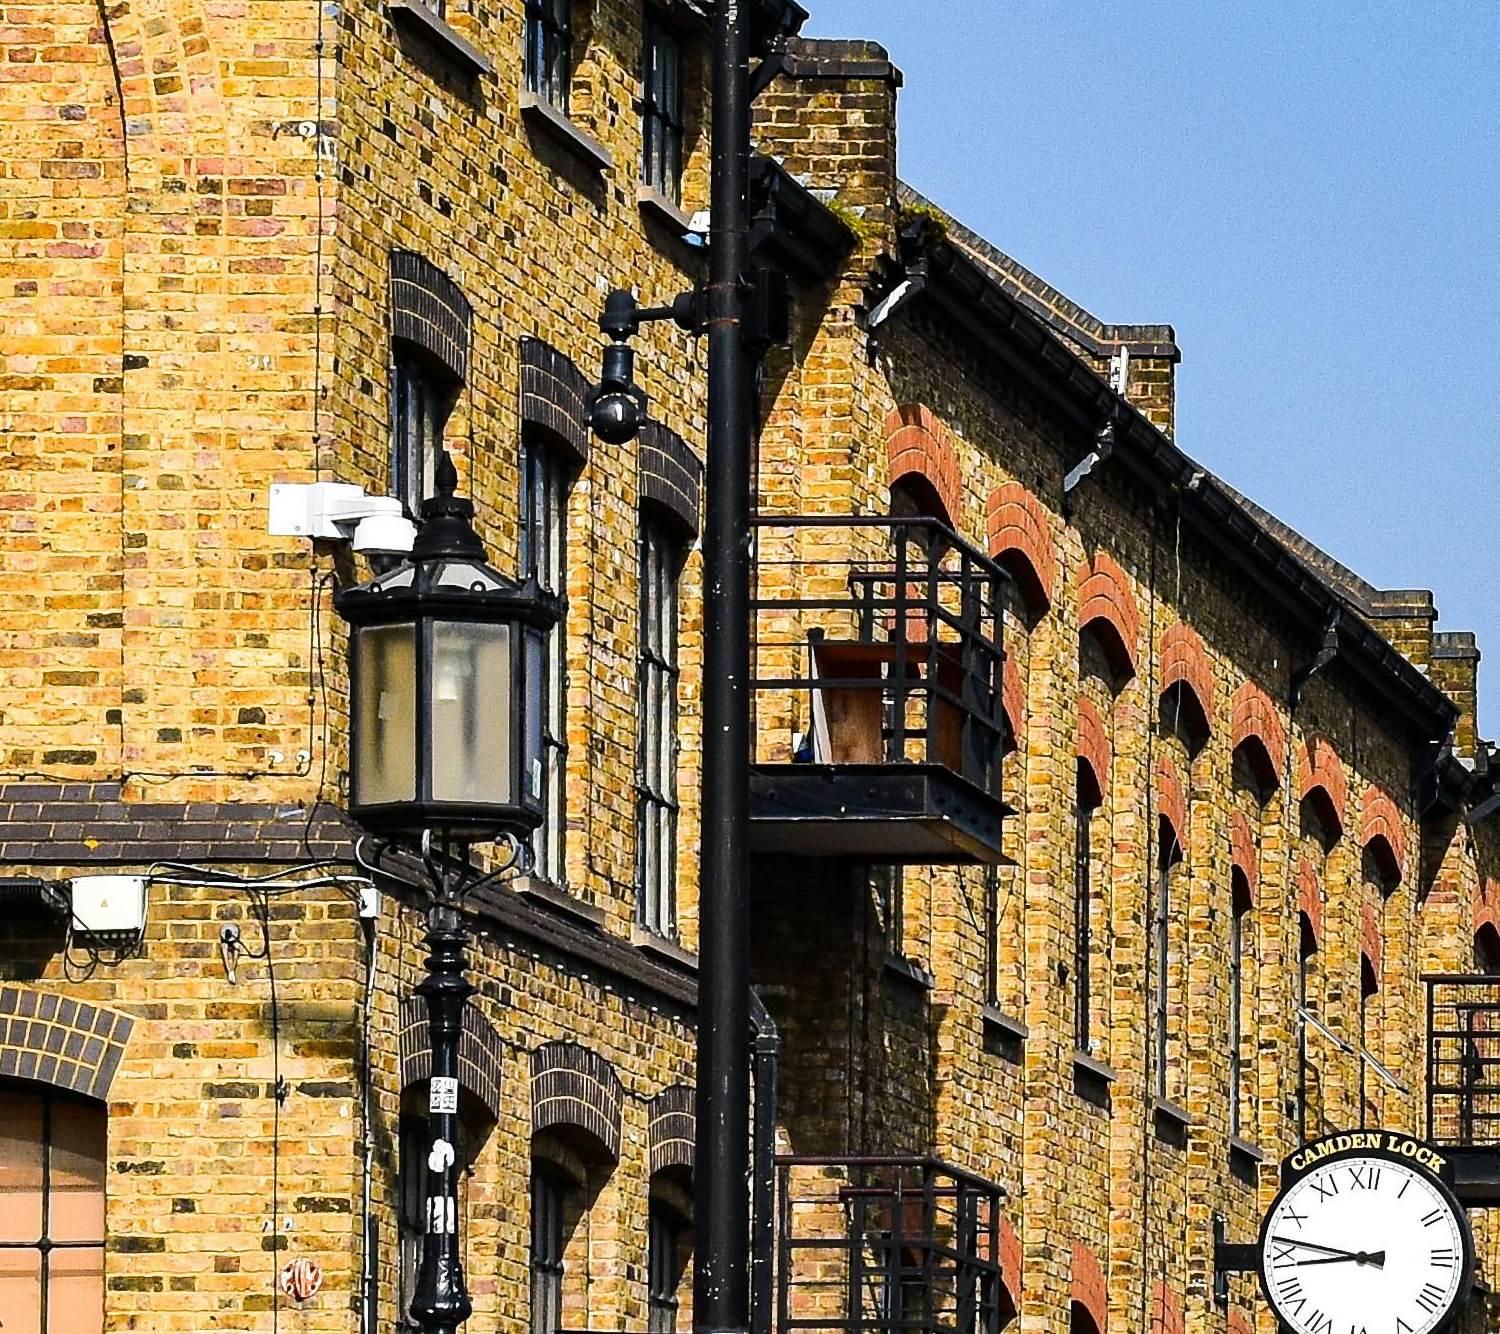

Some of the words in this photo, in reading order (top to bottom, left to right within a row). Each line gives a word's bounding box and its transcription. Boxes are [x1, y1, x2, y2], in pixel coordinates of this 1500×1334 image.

[1290, 1133, 1382, 1171] CAMDEN
[1387, 1136, 1447, 1174] LOCK
[1310, 1173, 1339, 1203] XI
[1348, 1167, 1381, 1190] XII
[1282, 1205, 1308, 1229] X
